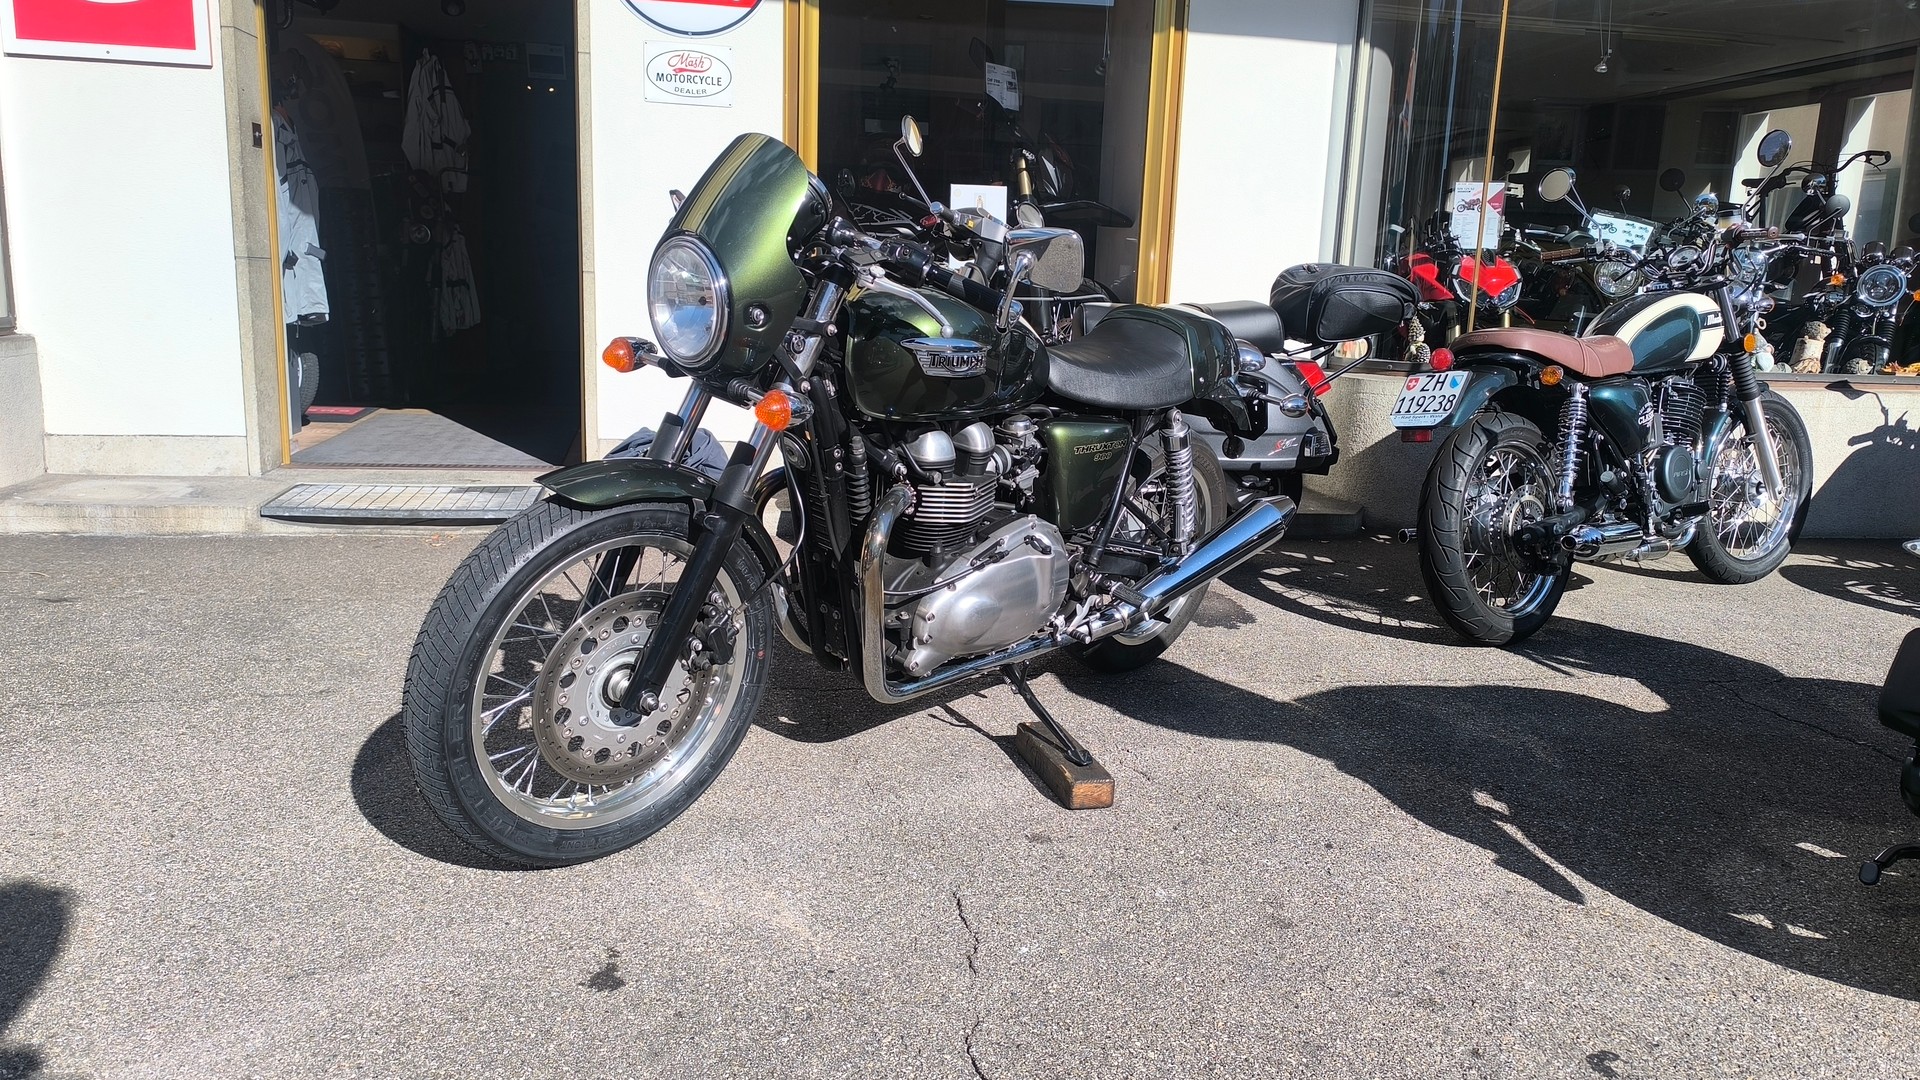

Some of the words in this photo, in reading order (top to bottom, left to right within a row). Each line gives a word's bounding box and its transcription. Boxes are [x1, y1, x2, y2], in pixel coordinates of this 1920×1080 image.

[667, 52, 712, 73] Mash
[655, 72, 722, 87] MOTORCYCLE
[674, 86, 707, 95] DEALER
[928, 352, 985, 372] TRIUMPH
[1420, 373, 1449, 392] ZH
[1395, 393, 1457, 414] 119238
[1073, 438, 1128, 455] THRUXTON
[1093, 451, 1113, 462] 900
